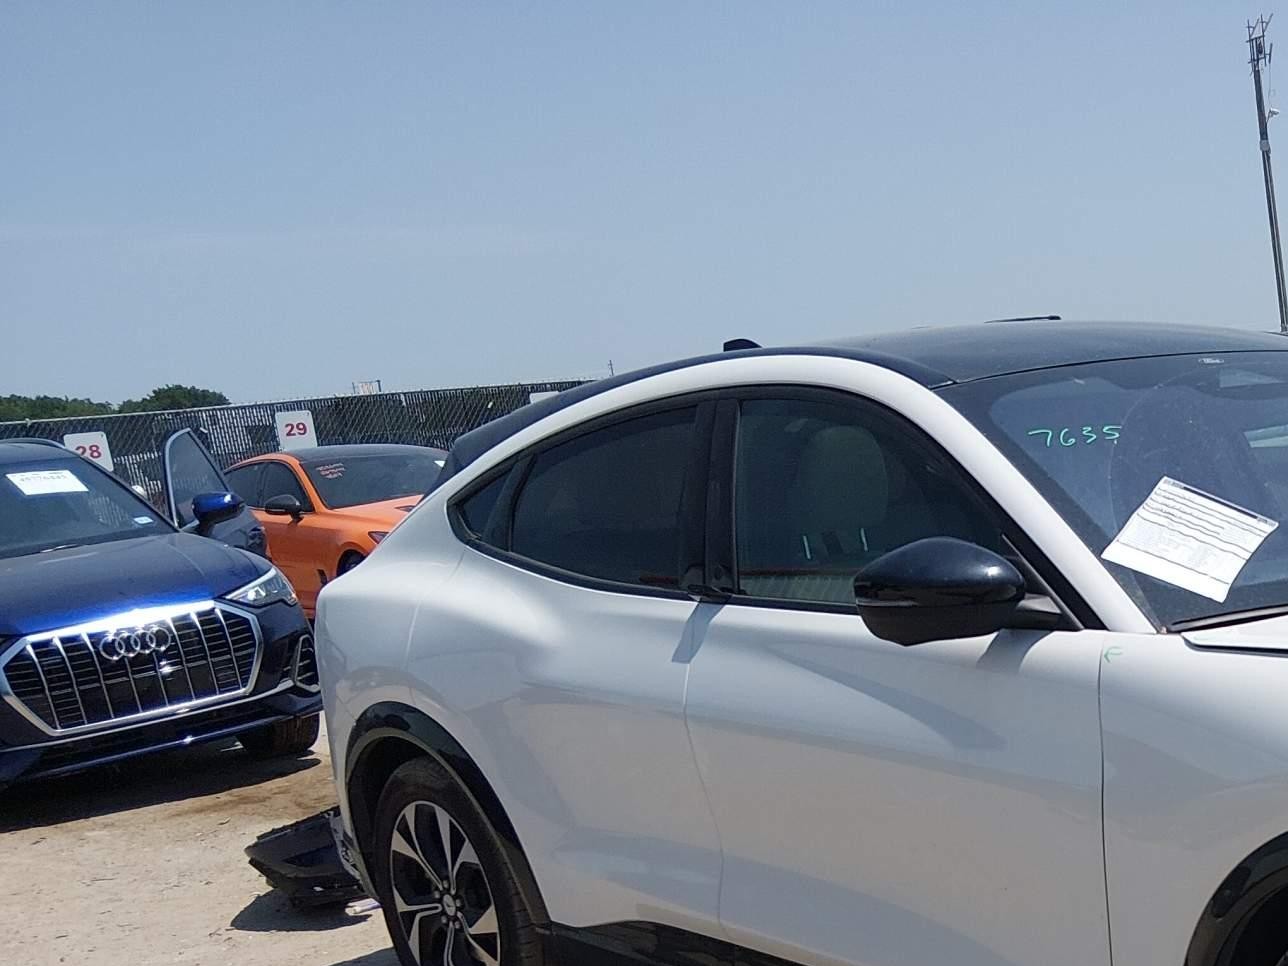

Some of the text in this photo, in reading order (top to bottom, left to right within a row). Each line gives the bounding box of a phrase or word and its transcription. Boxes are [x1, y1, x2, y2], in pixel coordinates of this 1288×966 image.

[285, 422, 307, 437] 29
[1027, 425, 1122, 447] 7635
[75, 444, 102, 459] 28
